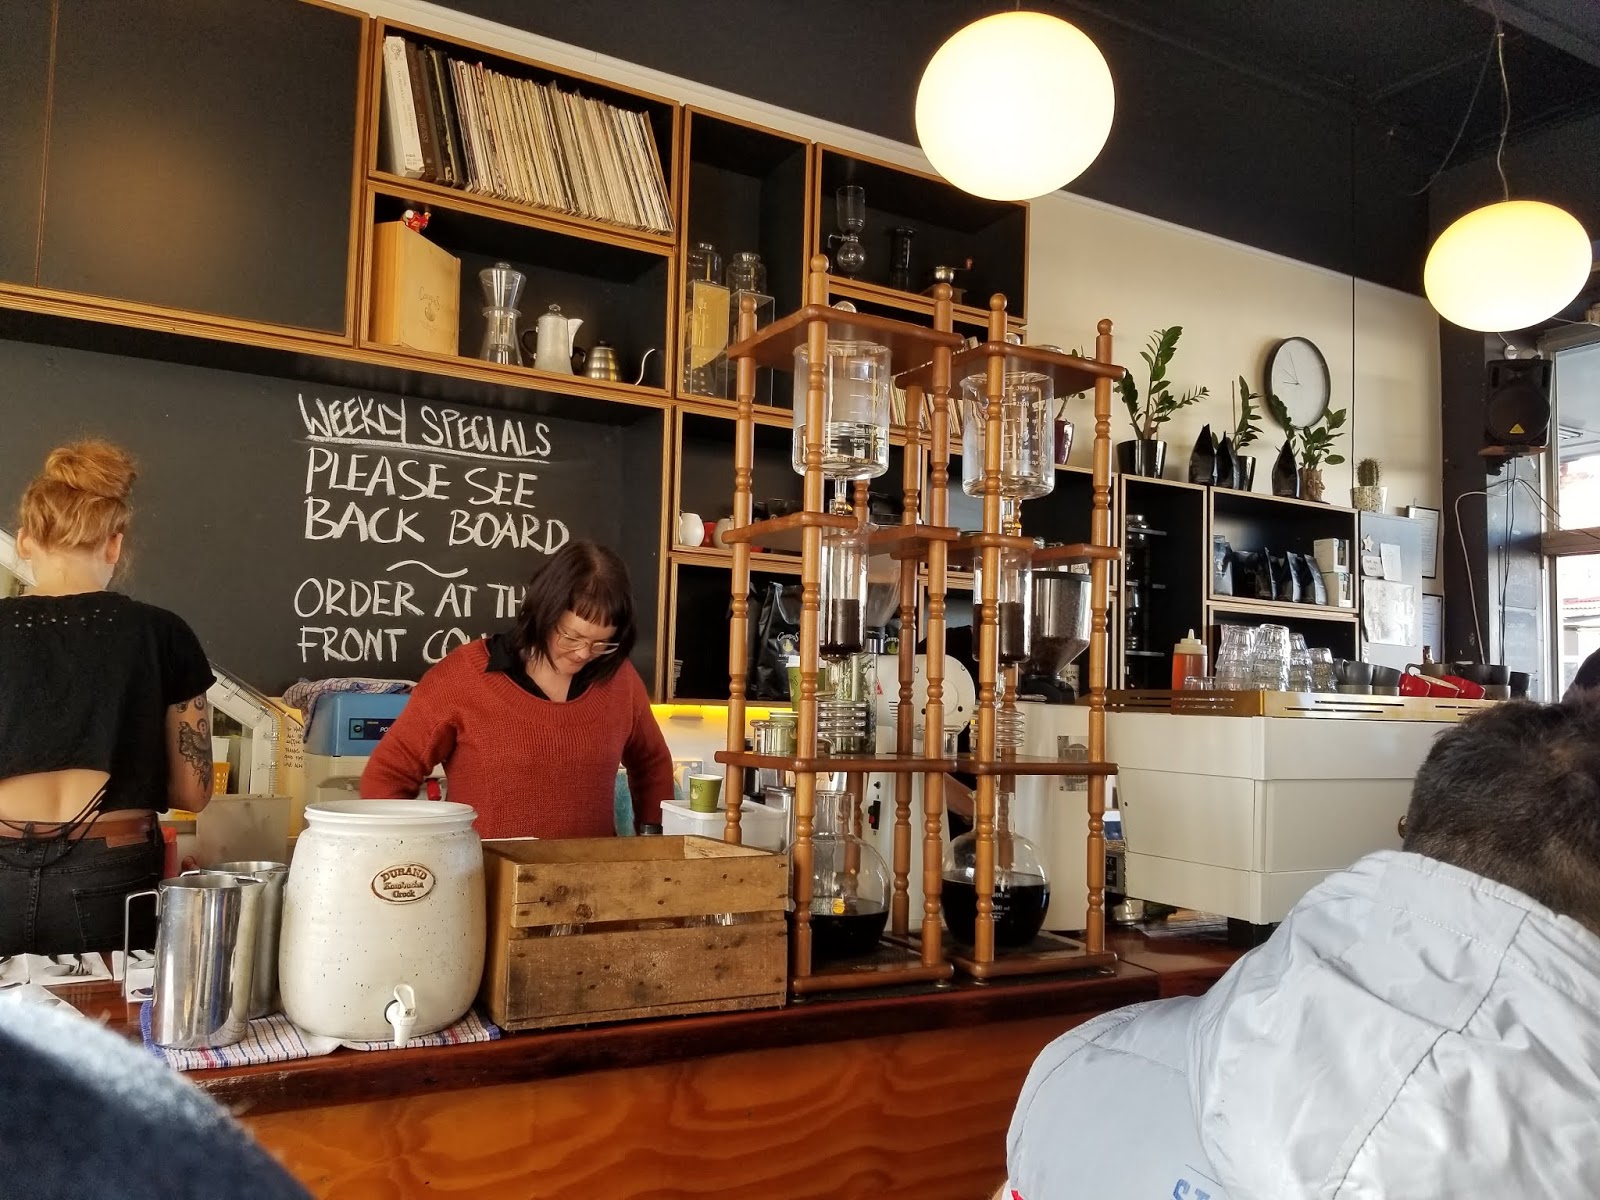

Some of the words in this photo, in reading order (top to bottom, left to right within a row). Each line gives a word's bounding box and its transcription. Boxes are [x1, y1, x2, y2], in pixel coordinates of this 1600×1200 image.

[298, 393, 407, 444] WEEKLY
[421, 405, 552, 457] SPECIALS
[305, 446, 452, 501] PLEASE
[464, 467, 539, 509] SEE
[303, 496, 425, 544] BACK
[449, 509, 570, 555] BOARD
[294, 577, 425, 618] ORDER
[434, 582, 479, 618] AT
[486, 583, 527, 618] TH
[297, 625, 408, 663] FRONT
[380, 867, 428, 882] DURAND
[392, 890, 416, 898] Crock
